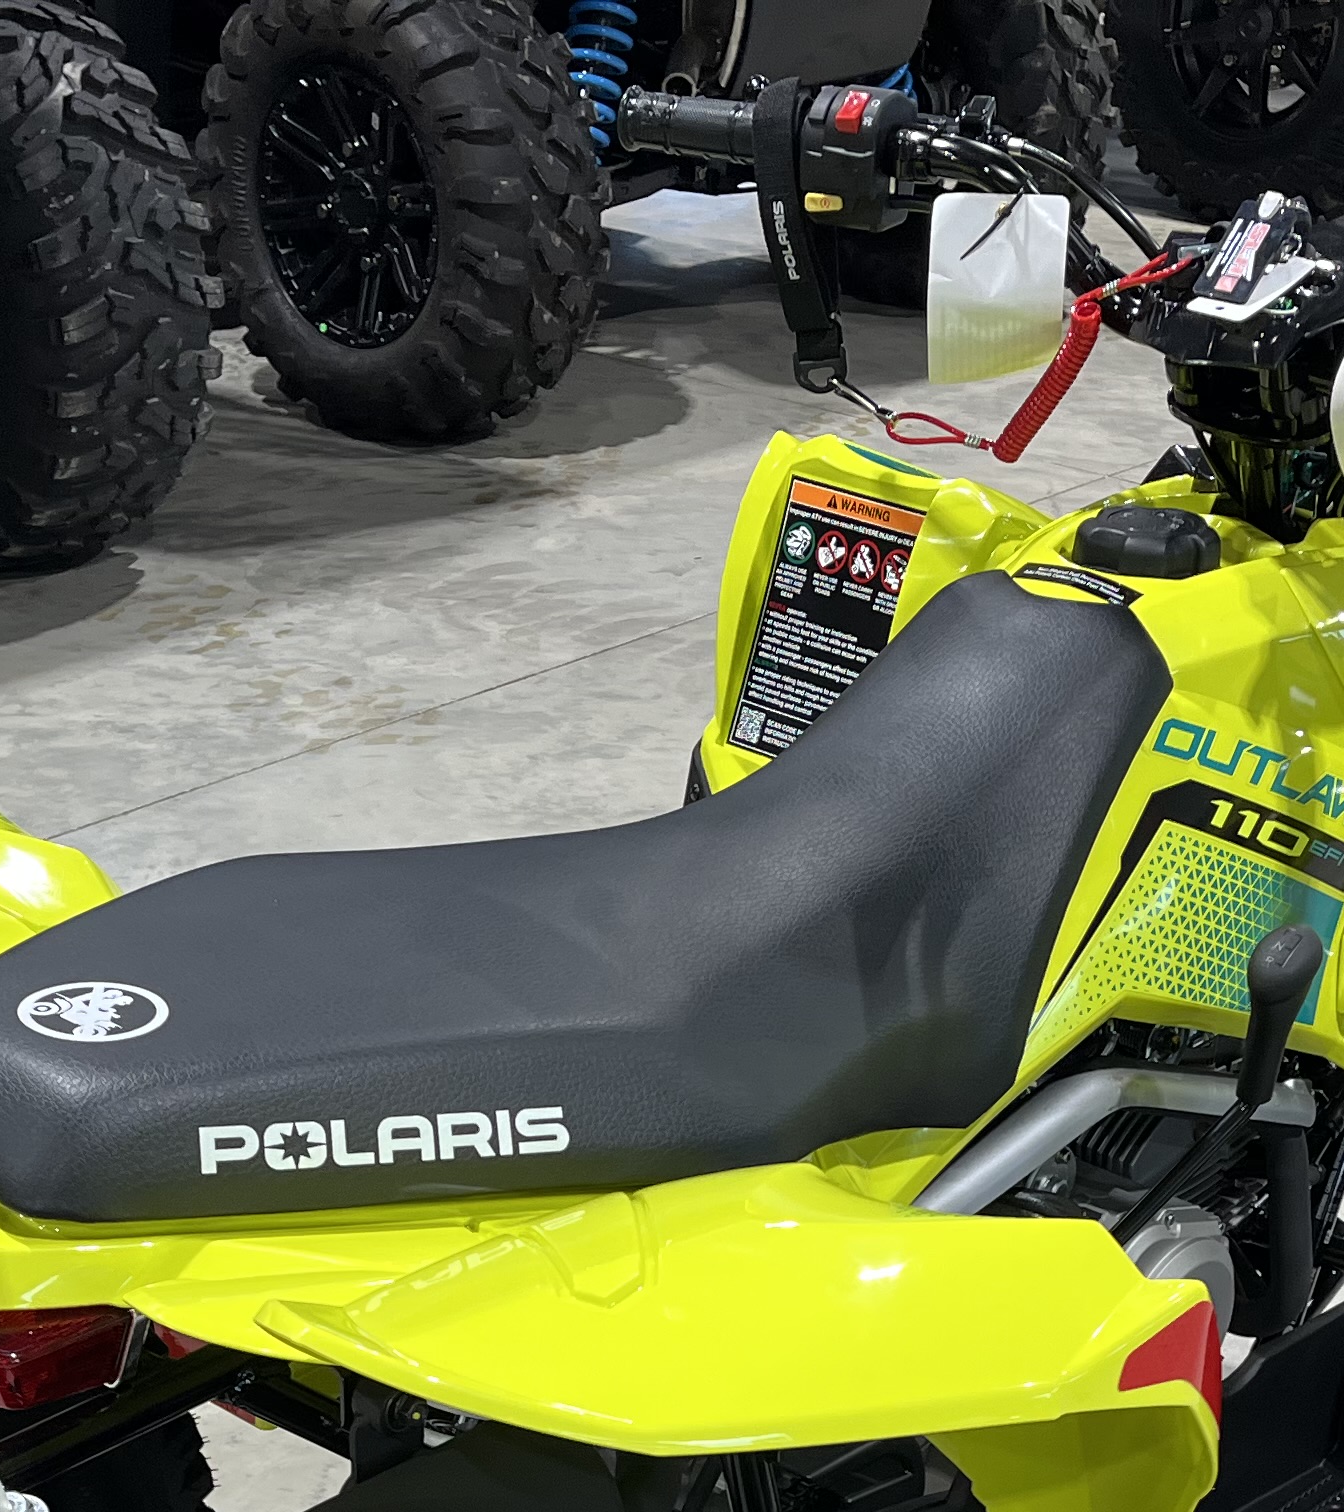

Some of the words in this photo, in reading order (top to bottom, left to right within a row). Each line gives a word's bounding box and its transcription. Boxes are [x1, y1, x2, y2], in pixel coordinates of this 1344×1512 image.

[772, 200, 801, 281] POLARIS
[840, 497, 891, 522] WARNING
[1210, 799, 1310, 857] 110
[198, 1106, 571, 1175] POLARIS
